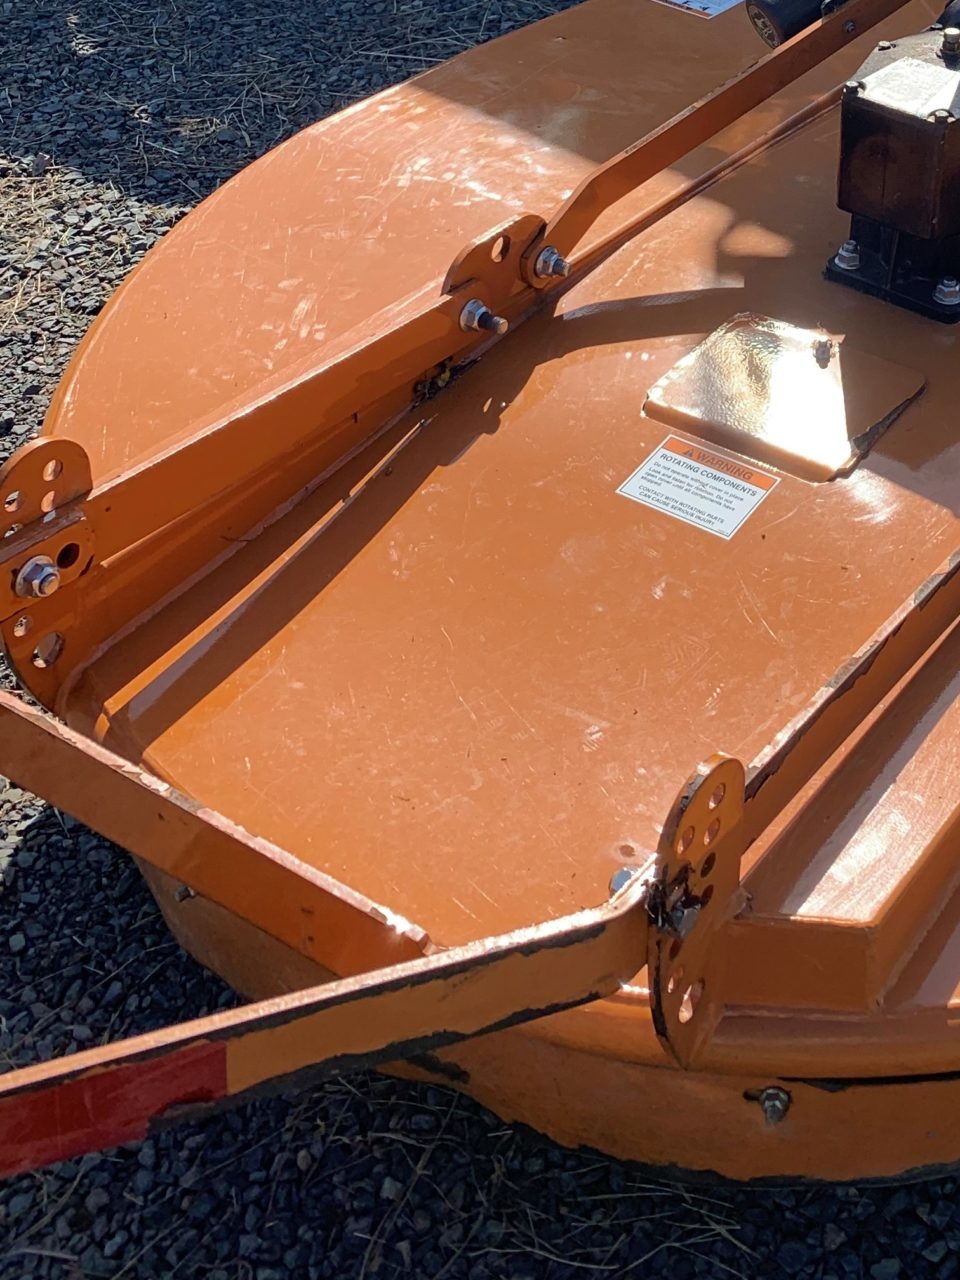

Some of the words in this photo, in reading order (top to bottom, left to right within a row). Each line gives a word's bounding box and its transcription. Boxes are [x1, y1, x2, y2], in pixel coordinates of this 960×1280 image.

[660, 453, 700, 473] ROTATING
[699, 470, 758, 497] COMPONENTS
[695, 452, 754, 481] WARNING
[638, 485, 664, 498] CONTACT
[664, 496, 679, 504] WITH
[639, 491, 652, 499] CAN
[651, 496, 671, 507] CAUSE
